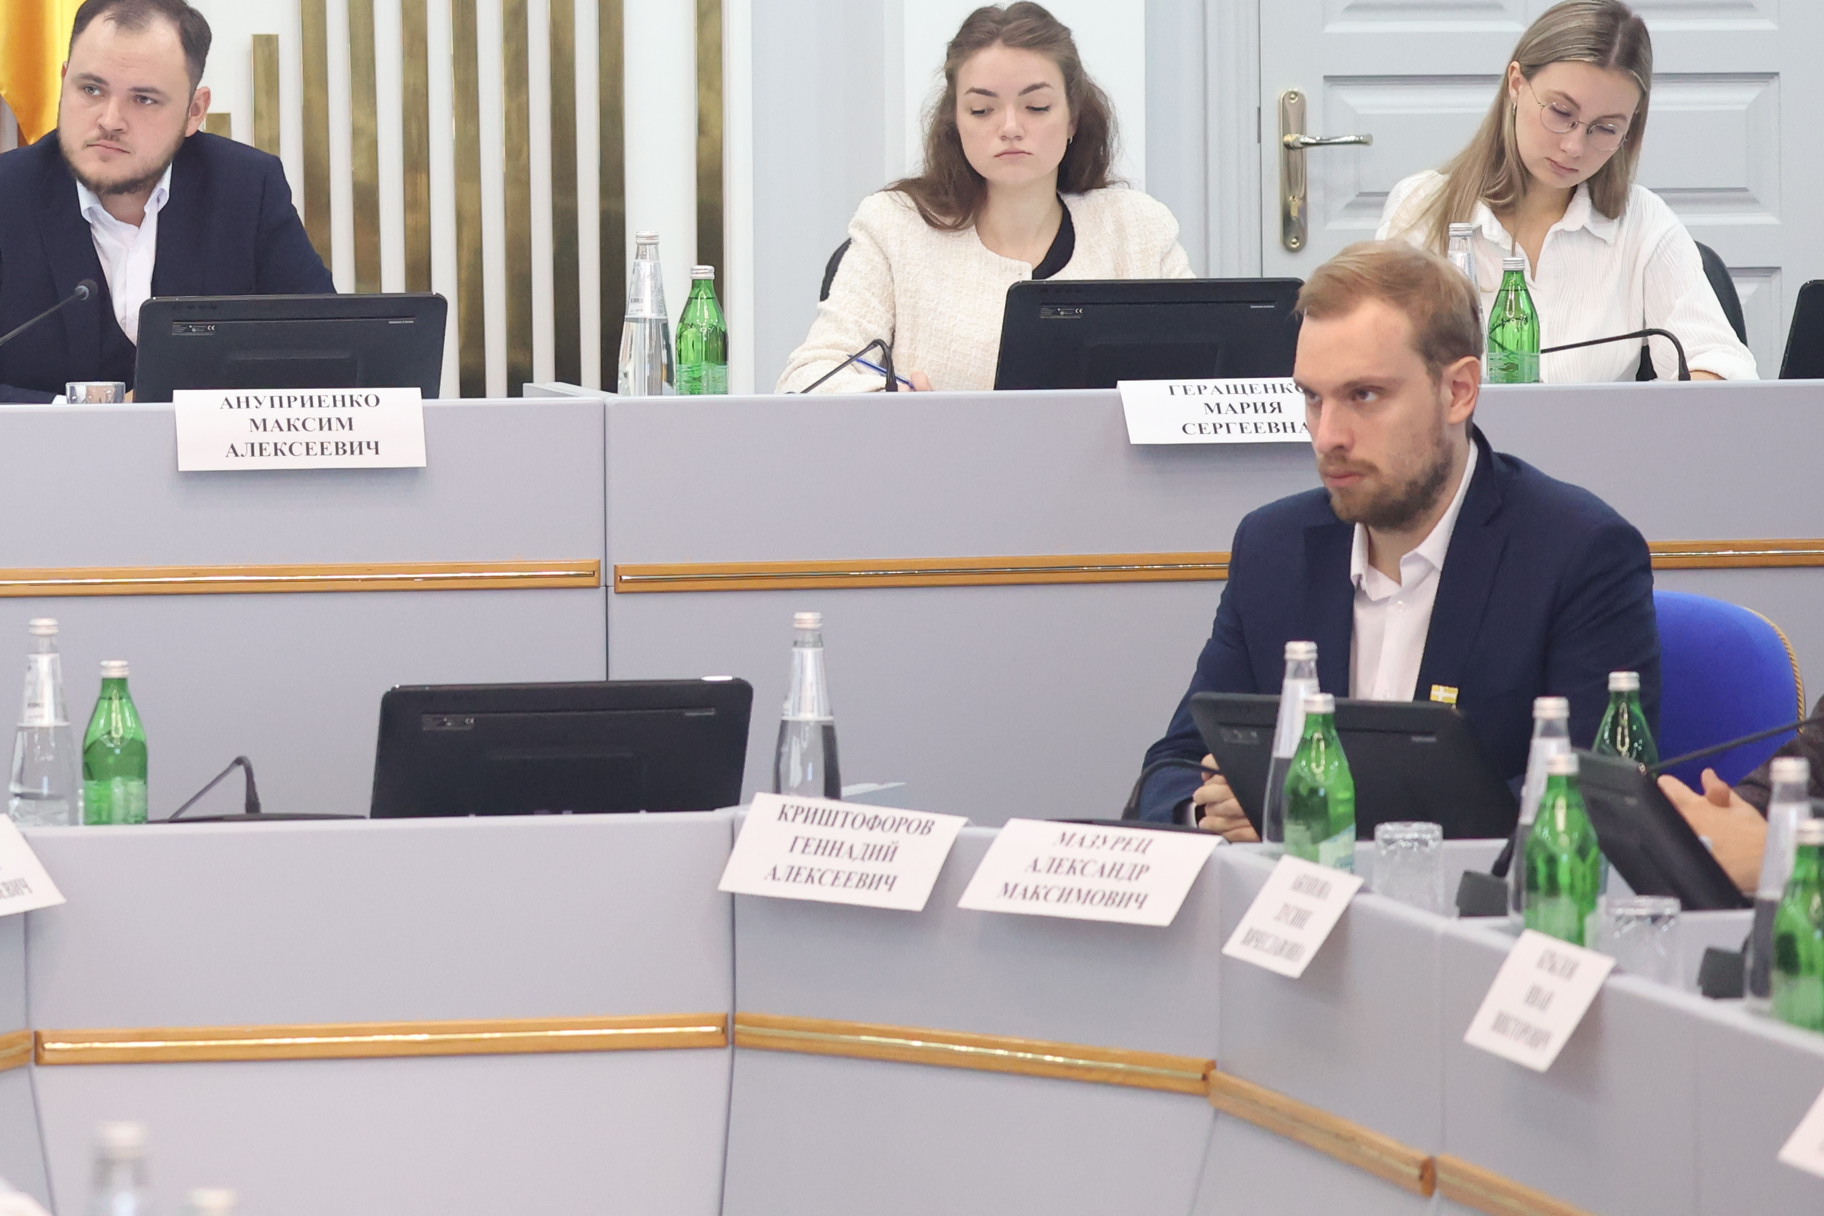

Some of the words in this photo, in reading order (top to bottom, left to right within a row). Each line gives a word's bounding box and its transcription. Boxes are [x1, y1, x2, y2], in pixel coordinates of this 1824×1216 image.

[220, 393, 381, 410] АНУПРИЕНКО
[1203, 401, 1283, 415] МАРИЯ
[249, 416, 354, 433] МАКСИМ
[225, 440, 381, 458] АЛЕКСЕЕВИЧ
[777, 803, 935, 836] КРИШТОФОРОВ
[788, 835, 899, 863] ГЕННАДИЙ
[764, 865, 898, 892] АЛЕКСЕЕВИЧ
[1025, 855, 1151, 882] АЛЕКСАНДР
[997, 881, 1150, 910] МАКСИМОВИЧ
